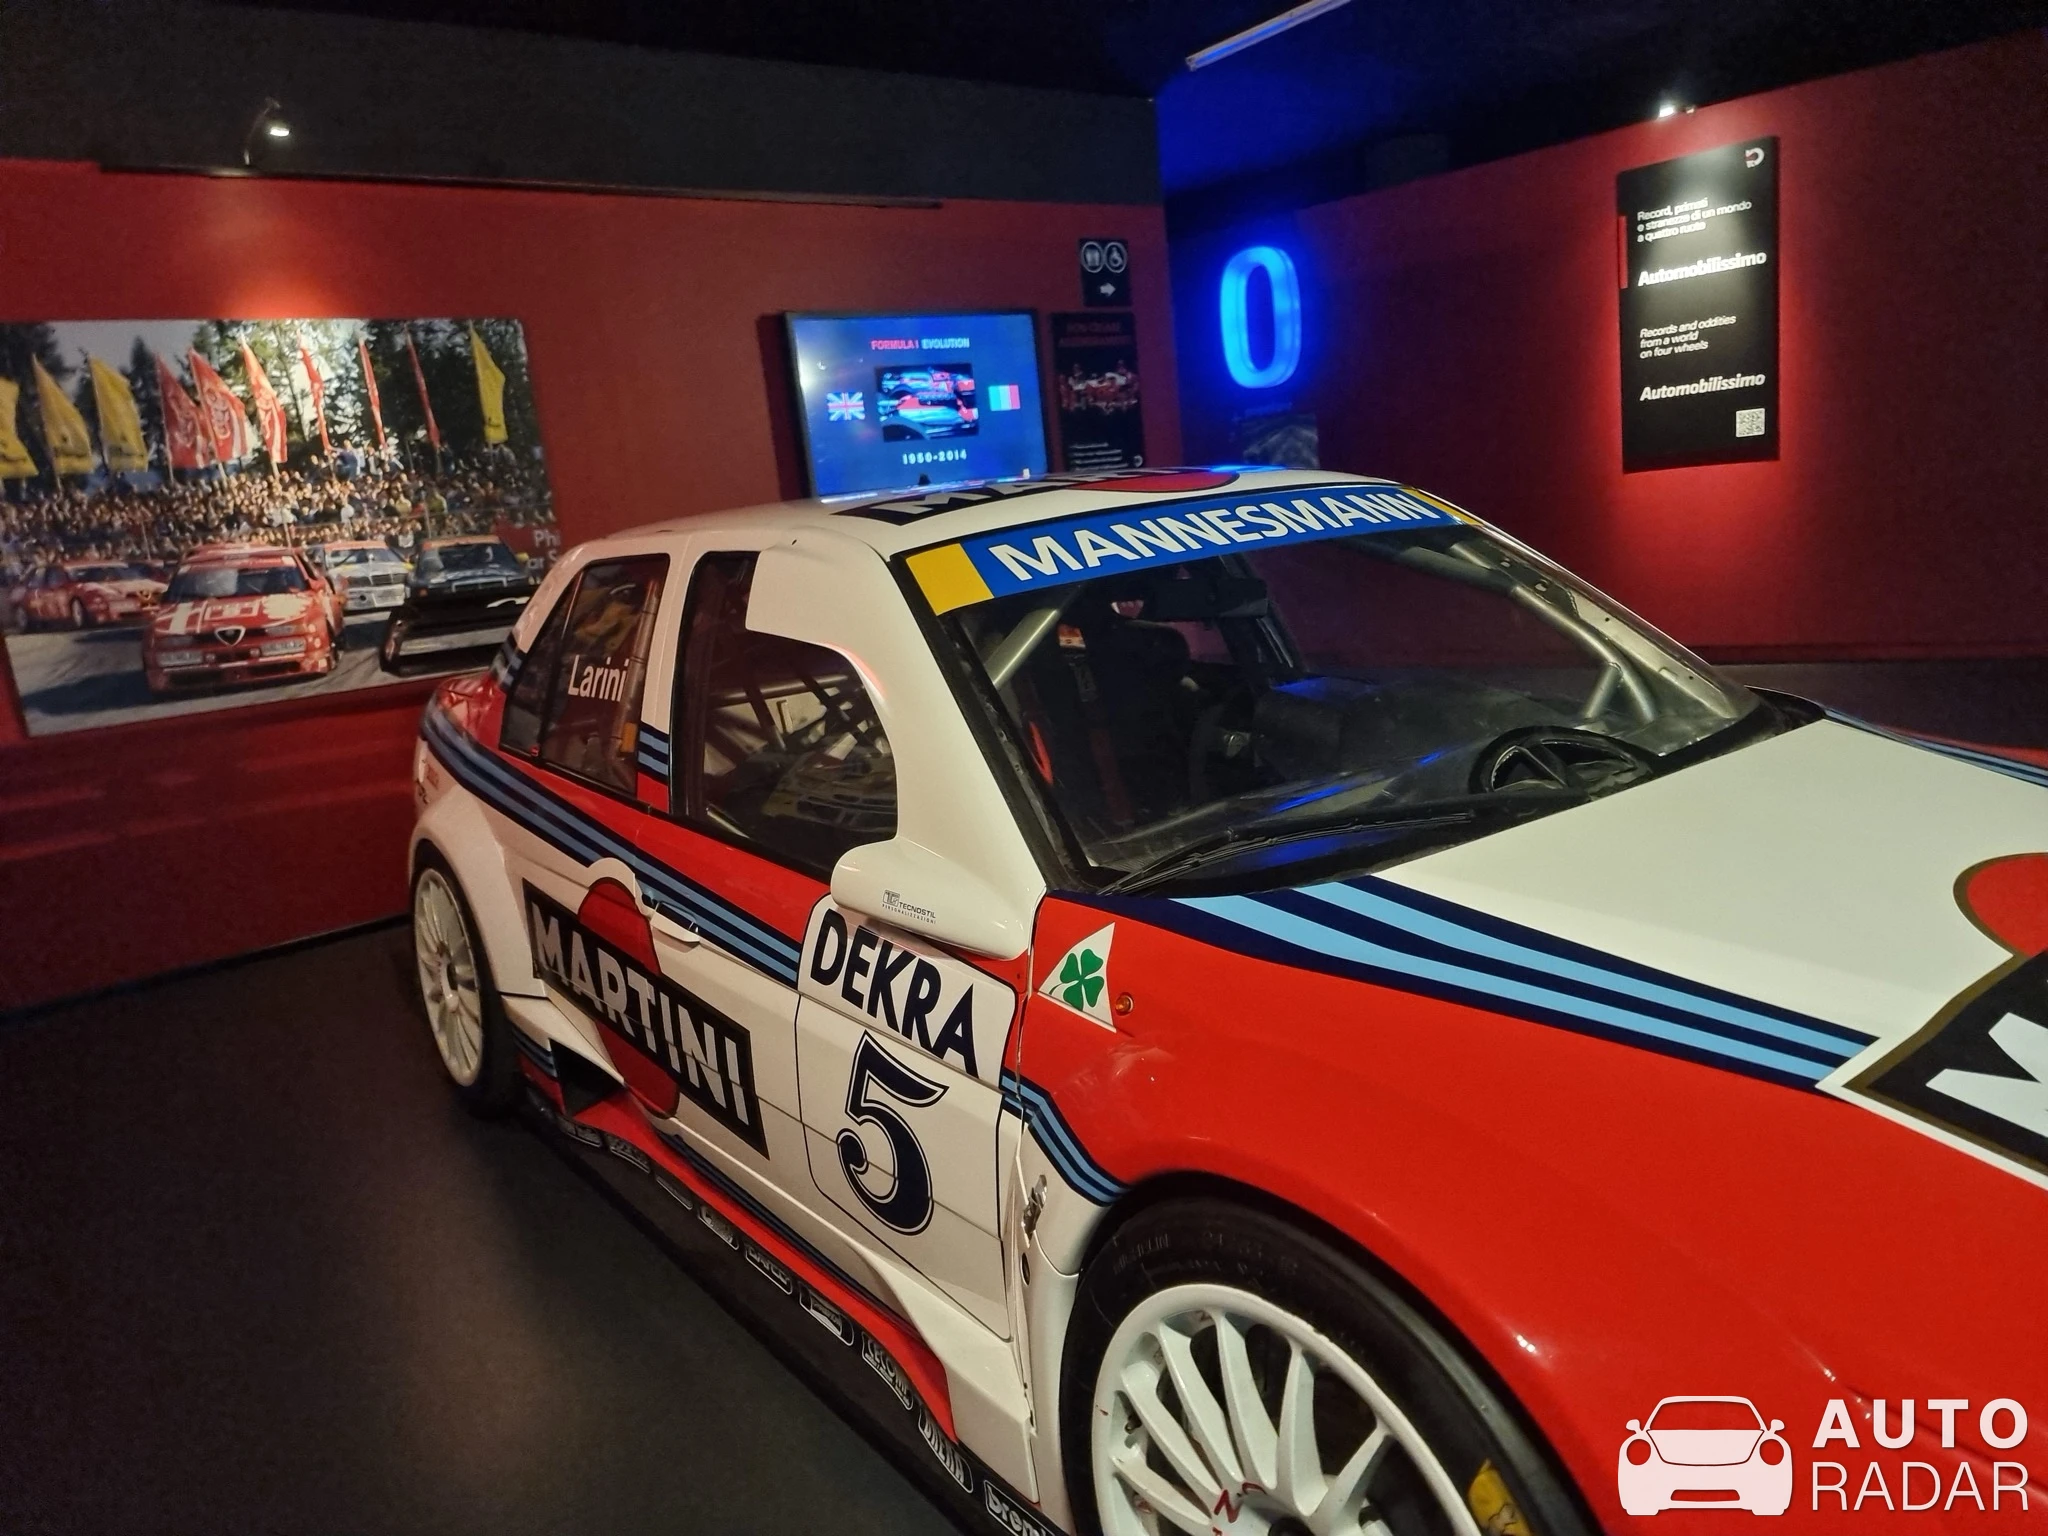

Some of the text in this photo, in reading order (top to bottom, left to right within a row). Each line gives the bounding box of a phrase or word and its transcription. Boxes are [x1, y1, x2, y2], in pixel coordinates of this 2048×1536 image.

[1637, 205, 1673, 221] Record,
[1716, 201, 1752, 216] mondo
[1637, 252, 1767, 287] Automobilissimo
[1640, 315, 1737, 338] Records and oddities
[871, 339, 914, 351] FORMULA
[921, 337, 970, 350] EVOLUTION
[1640, 330, 1699, 349] from a world
[1640, 340, 1709, 359] on four wheels
[1640, 373, 1766, 402] Automobilissimo
[902, 448, 967, 465] 1950-2014
[987, 491, 1441, 581] MANNESMANN
[568, 654, 630, 702] Larini
[899, 901, 936, 919] TECNOSTIL
[810, 908, 979, 1079] DEKRA
[531, 900, 749, 1126] MARTINI
[836, 1030, 949, 1236] 5
